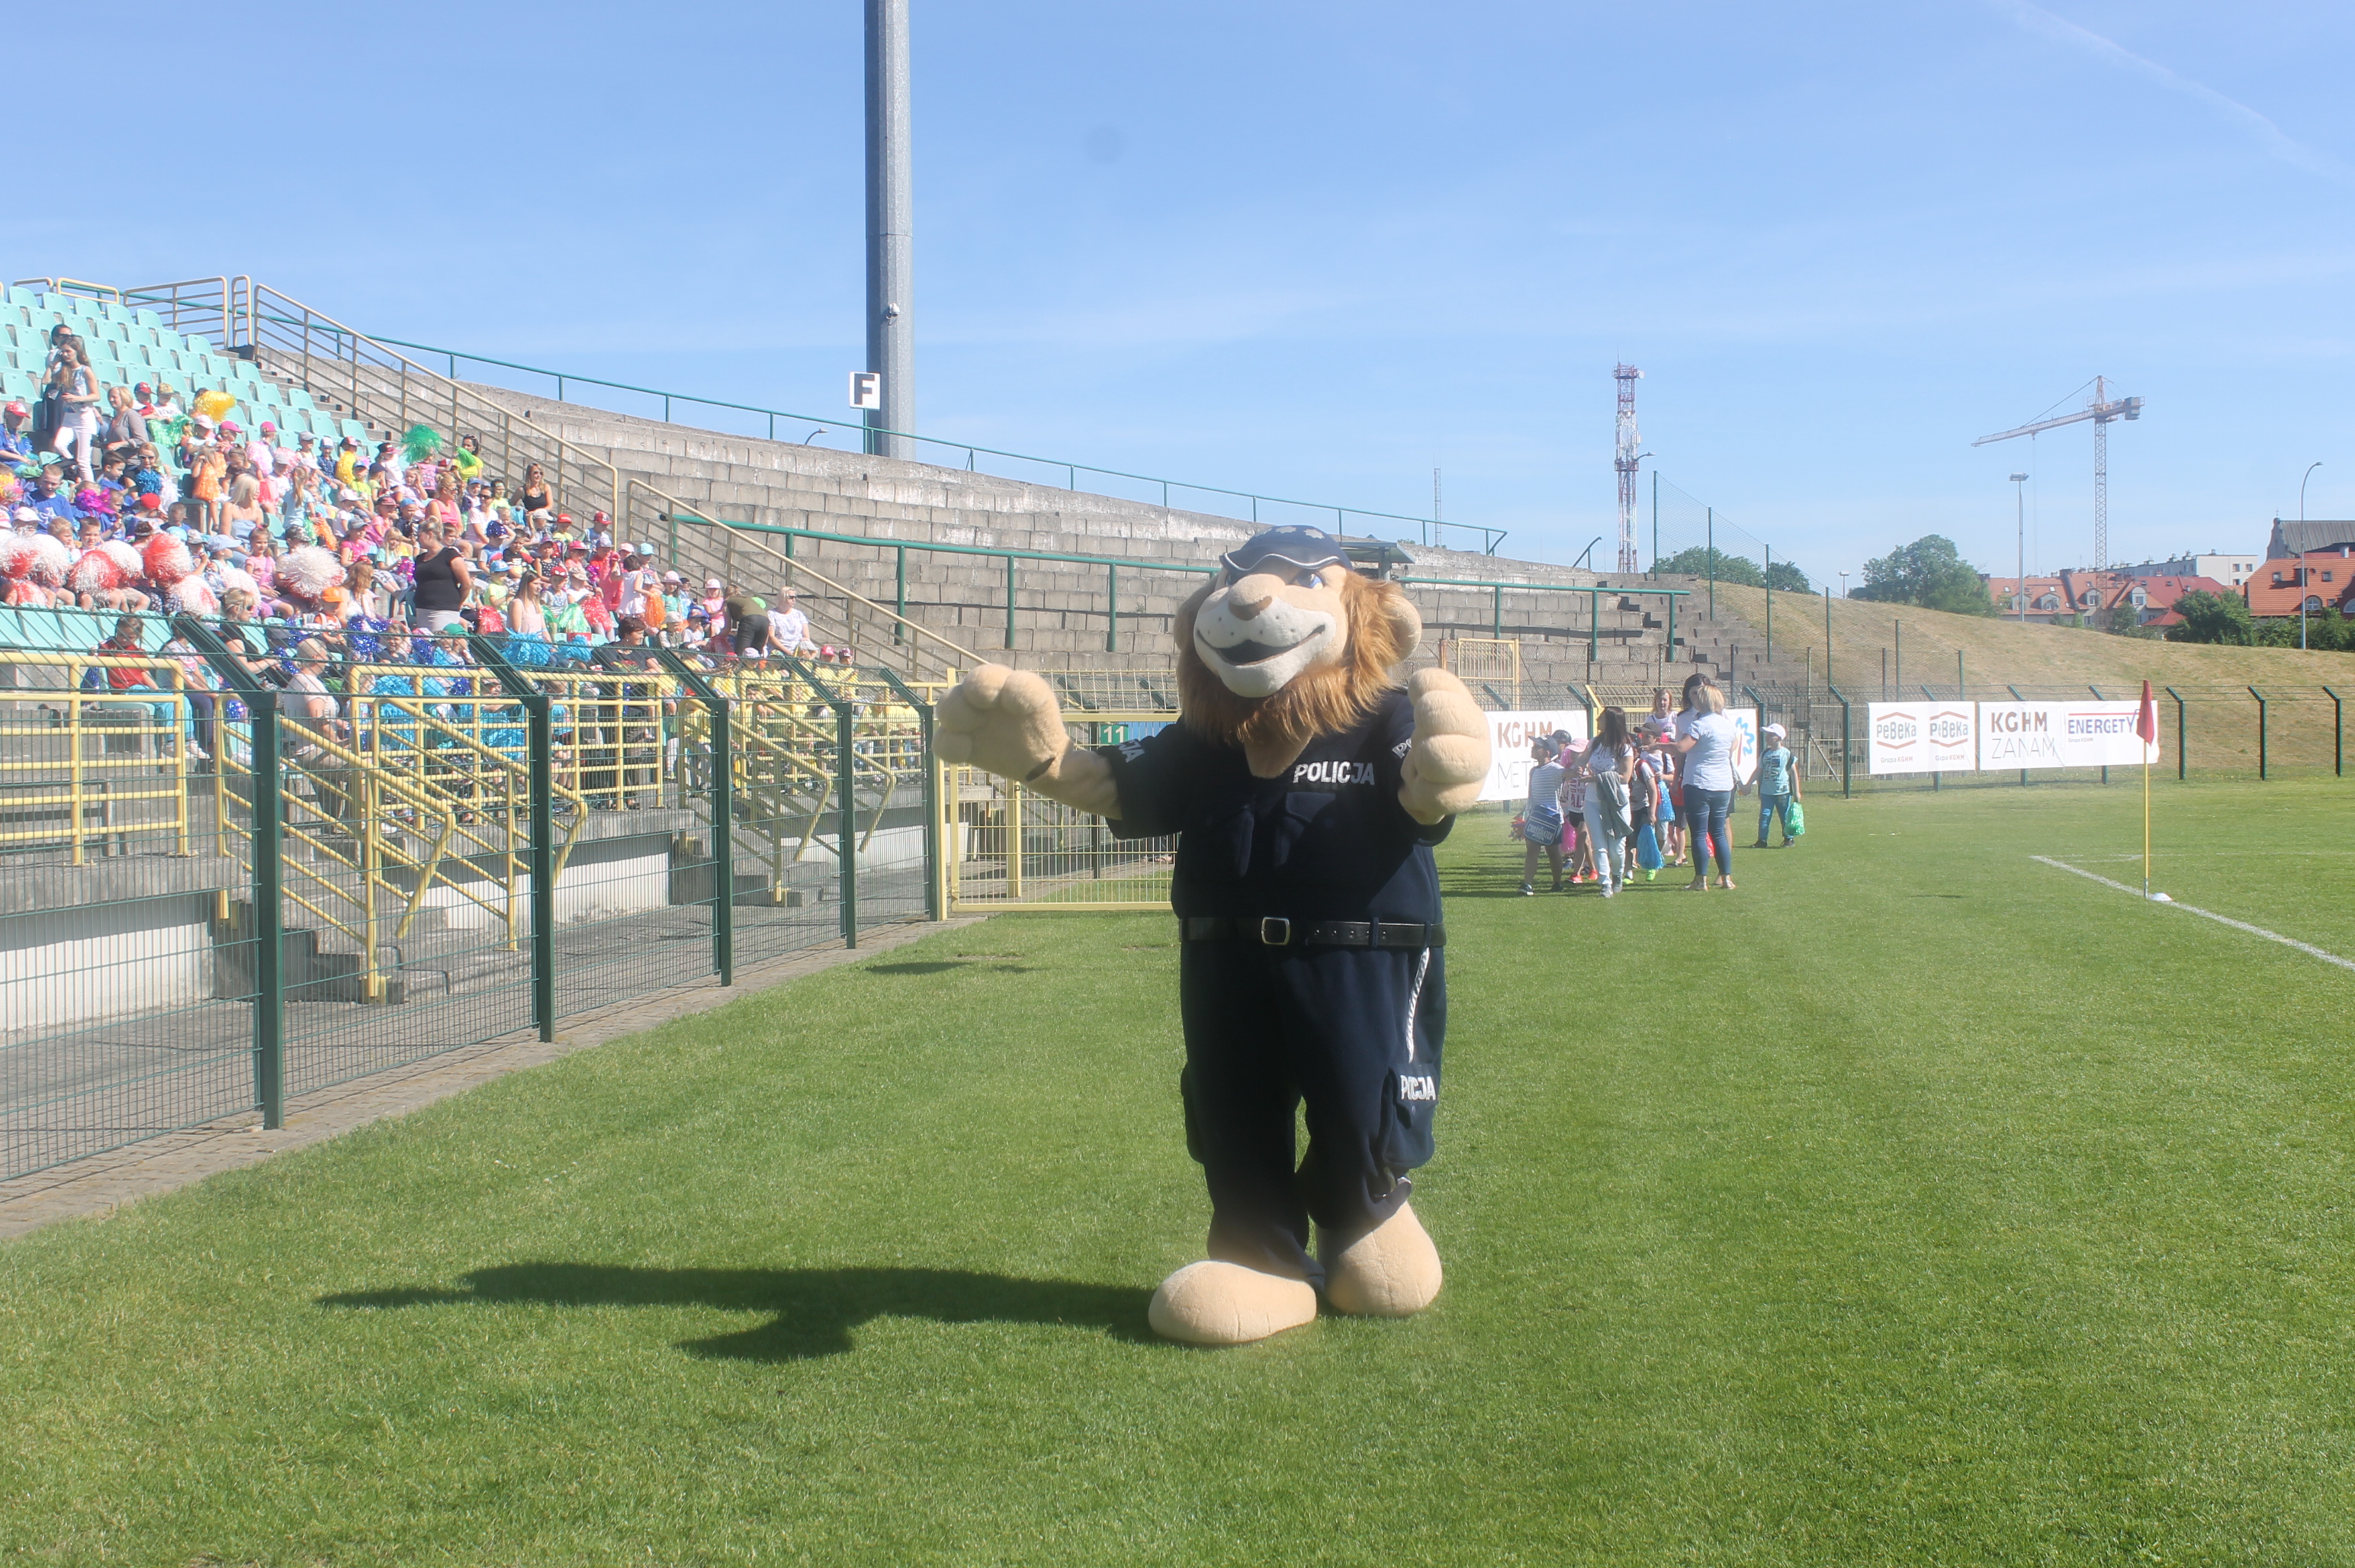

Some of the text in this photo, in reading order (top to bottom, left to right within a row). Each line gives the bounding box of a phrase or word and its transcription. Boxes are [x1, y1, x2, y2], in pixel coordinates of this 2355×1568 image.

[854, 373, 875, 405] F
[1991, 712, 2048, 733] KGHM
[2068, 711, 2140, 734] ENERGETY
[1103, 725, 1125, 744] 11
[1498, 721, 1553, 749] KGHM
[1991, 737, 2055, 759] ZANAM
[1293, 760, 1375, 786] POLICJA
